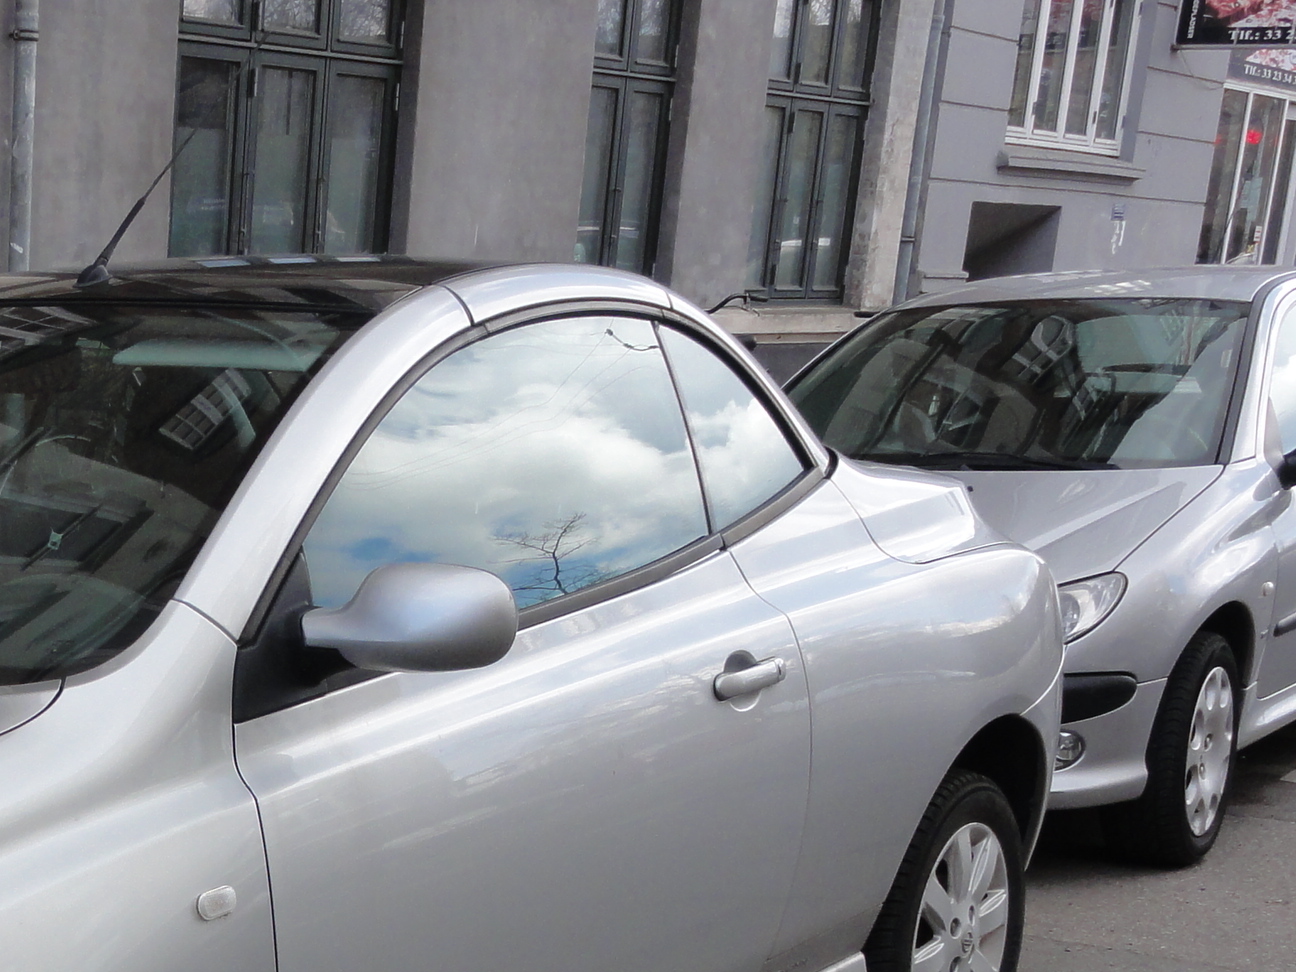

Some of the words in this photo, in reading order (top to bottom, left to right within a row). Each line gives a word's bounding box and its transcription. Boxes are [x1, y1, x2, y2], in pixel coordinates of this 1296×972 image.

[1228, 30, 1260, 40] Tlf.:
[1263, 30, 1281, 40] 33
[1286, 30, 1296, 40] 2
[1261, 69, 1272, 79] 33
[1272, 71, 1282, 81] 23
[1282, 73, 1292, 84] 34
